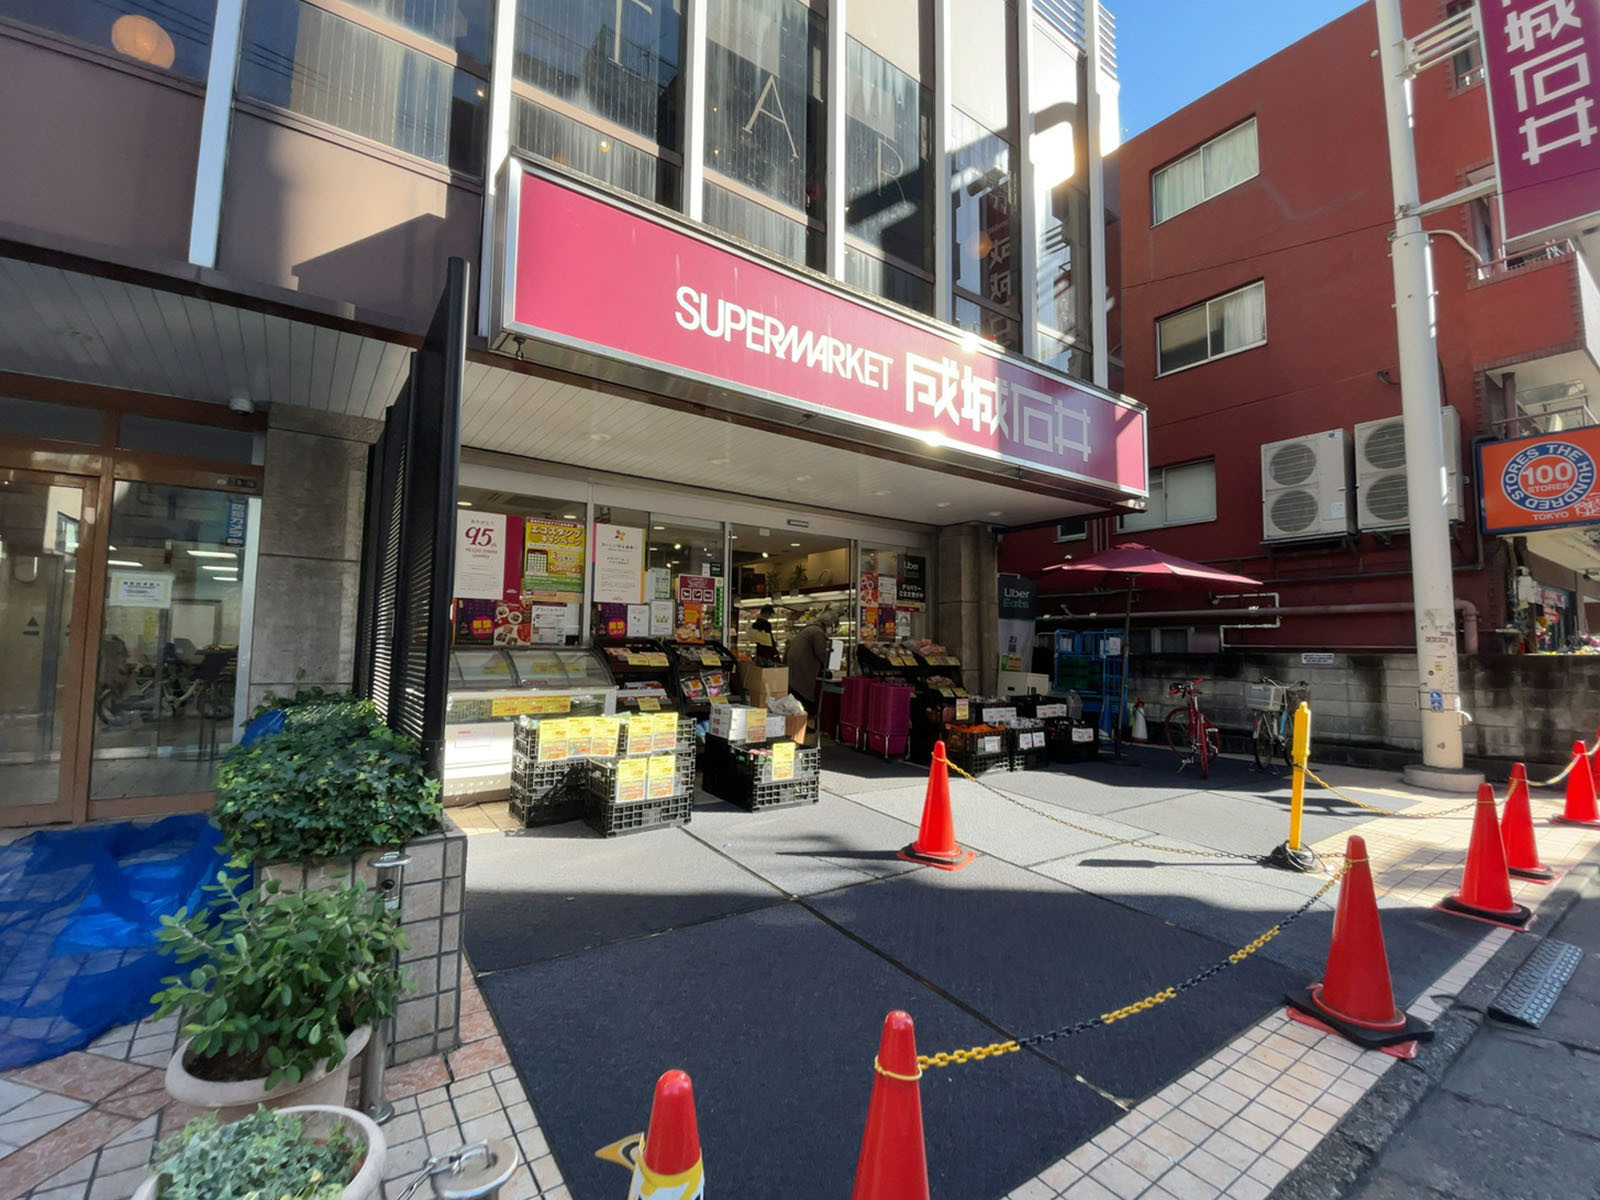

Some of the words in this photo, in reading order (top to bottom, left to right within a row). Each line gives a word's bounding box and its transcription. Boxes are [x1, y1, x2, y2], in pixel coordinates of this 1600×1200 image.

[1502, 0, 1597, 165] 城石井
[675, 286, 894, 391] SUPERMARKET
[905, 351, 1092, 463] 成城石井
[1546, 444, 1583, 462] THE
[1504, 448, 1540, 501] STORES
[1521, 461, 1574, 486] 100
[1524, 460, 1593, 510] HUNDRED
[1527, 481, 1571, 494] STORES
[1531, 510, 1570, 521] TOKYO
[903, 560, 919, 570] Uber
[1003, 587, 1030, 599] Uber
[1003, 598, 1029, 609] Eats
